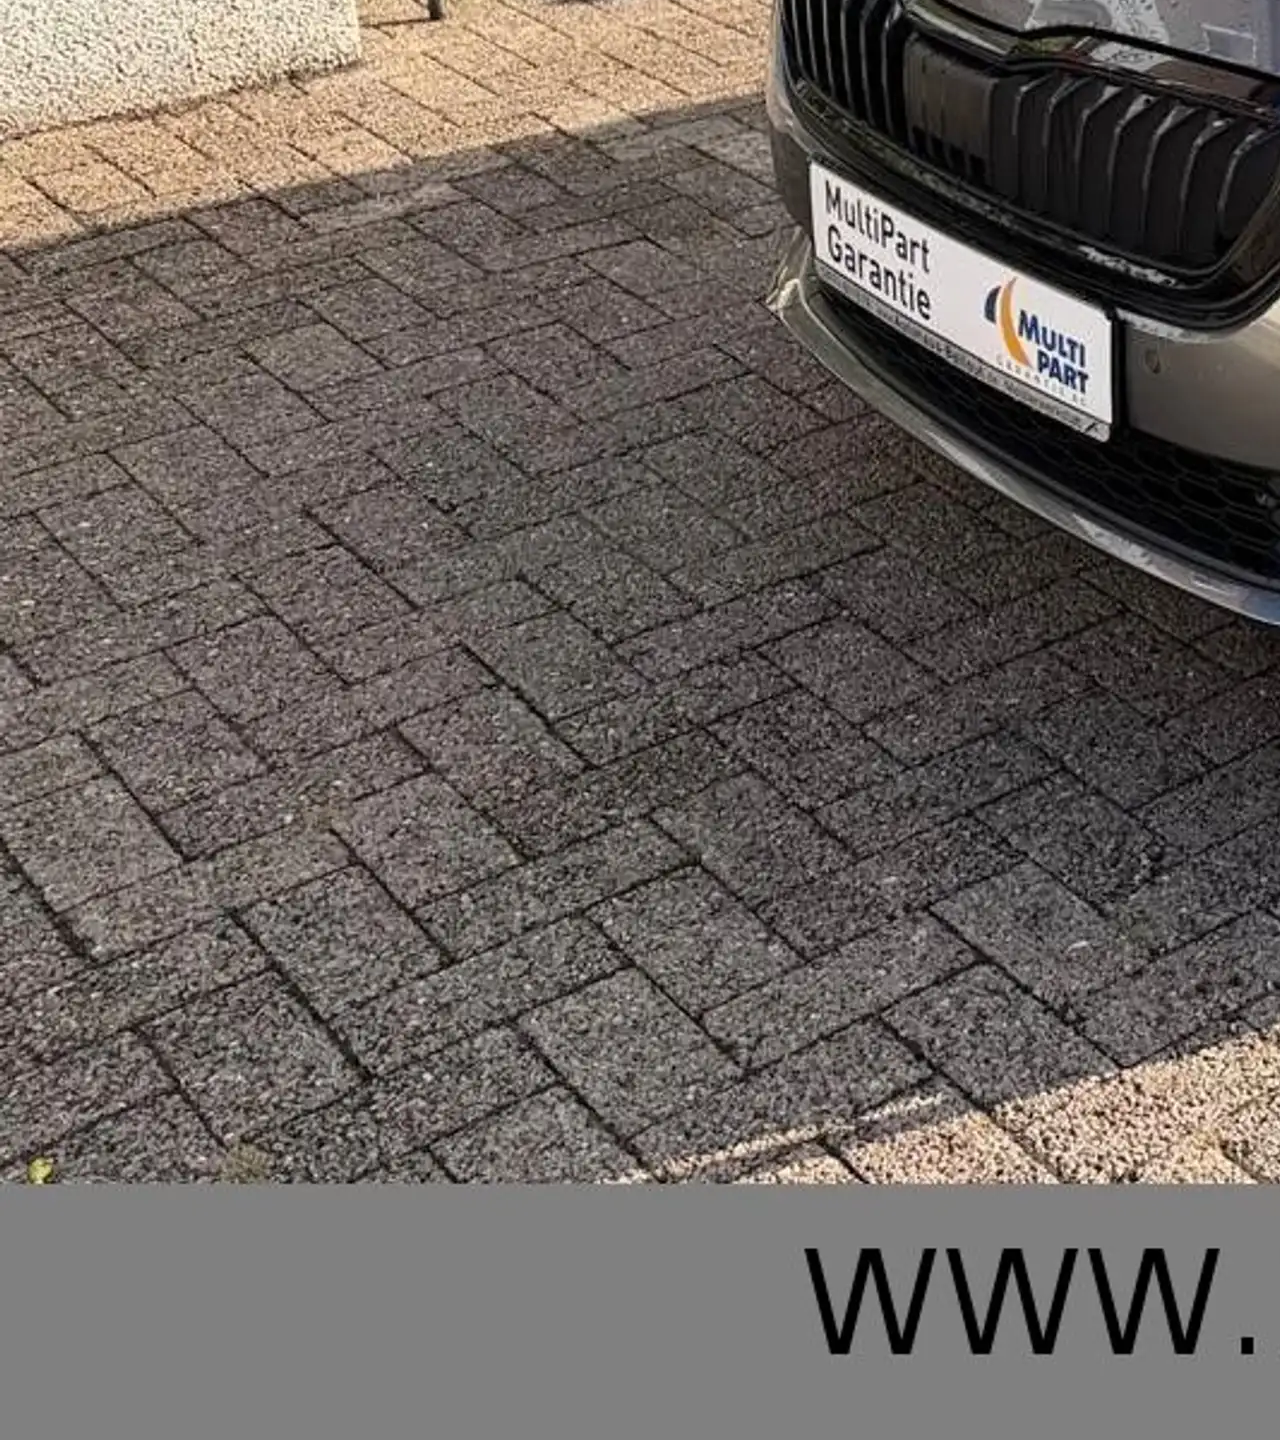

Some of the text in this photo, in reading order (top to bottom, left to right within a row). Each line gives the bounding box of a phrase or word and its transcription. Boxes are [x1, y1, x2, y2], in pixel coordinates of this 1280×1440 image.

[825, 179, 931, 275] MultiPart
[827, 224, 932, 321] Garantie
[1018, 308, 1086, 368] MULTI
[1036, 349, 1090, 395] PART
